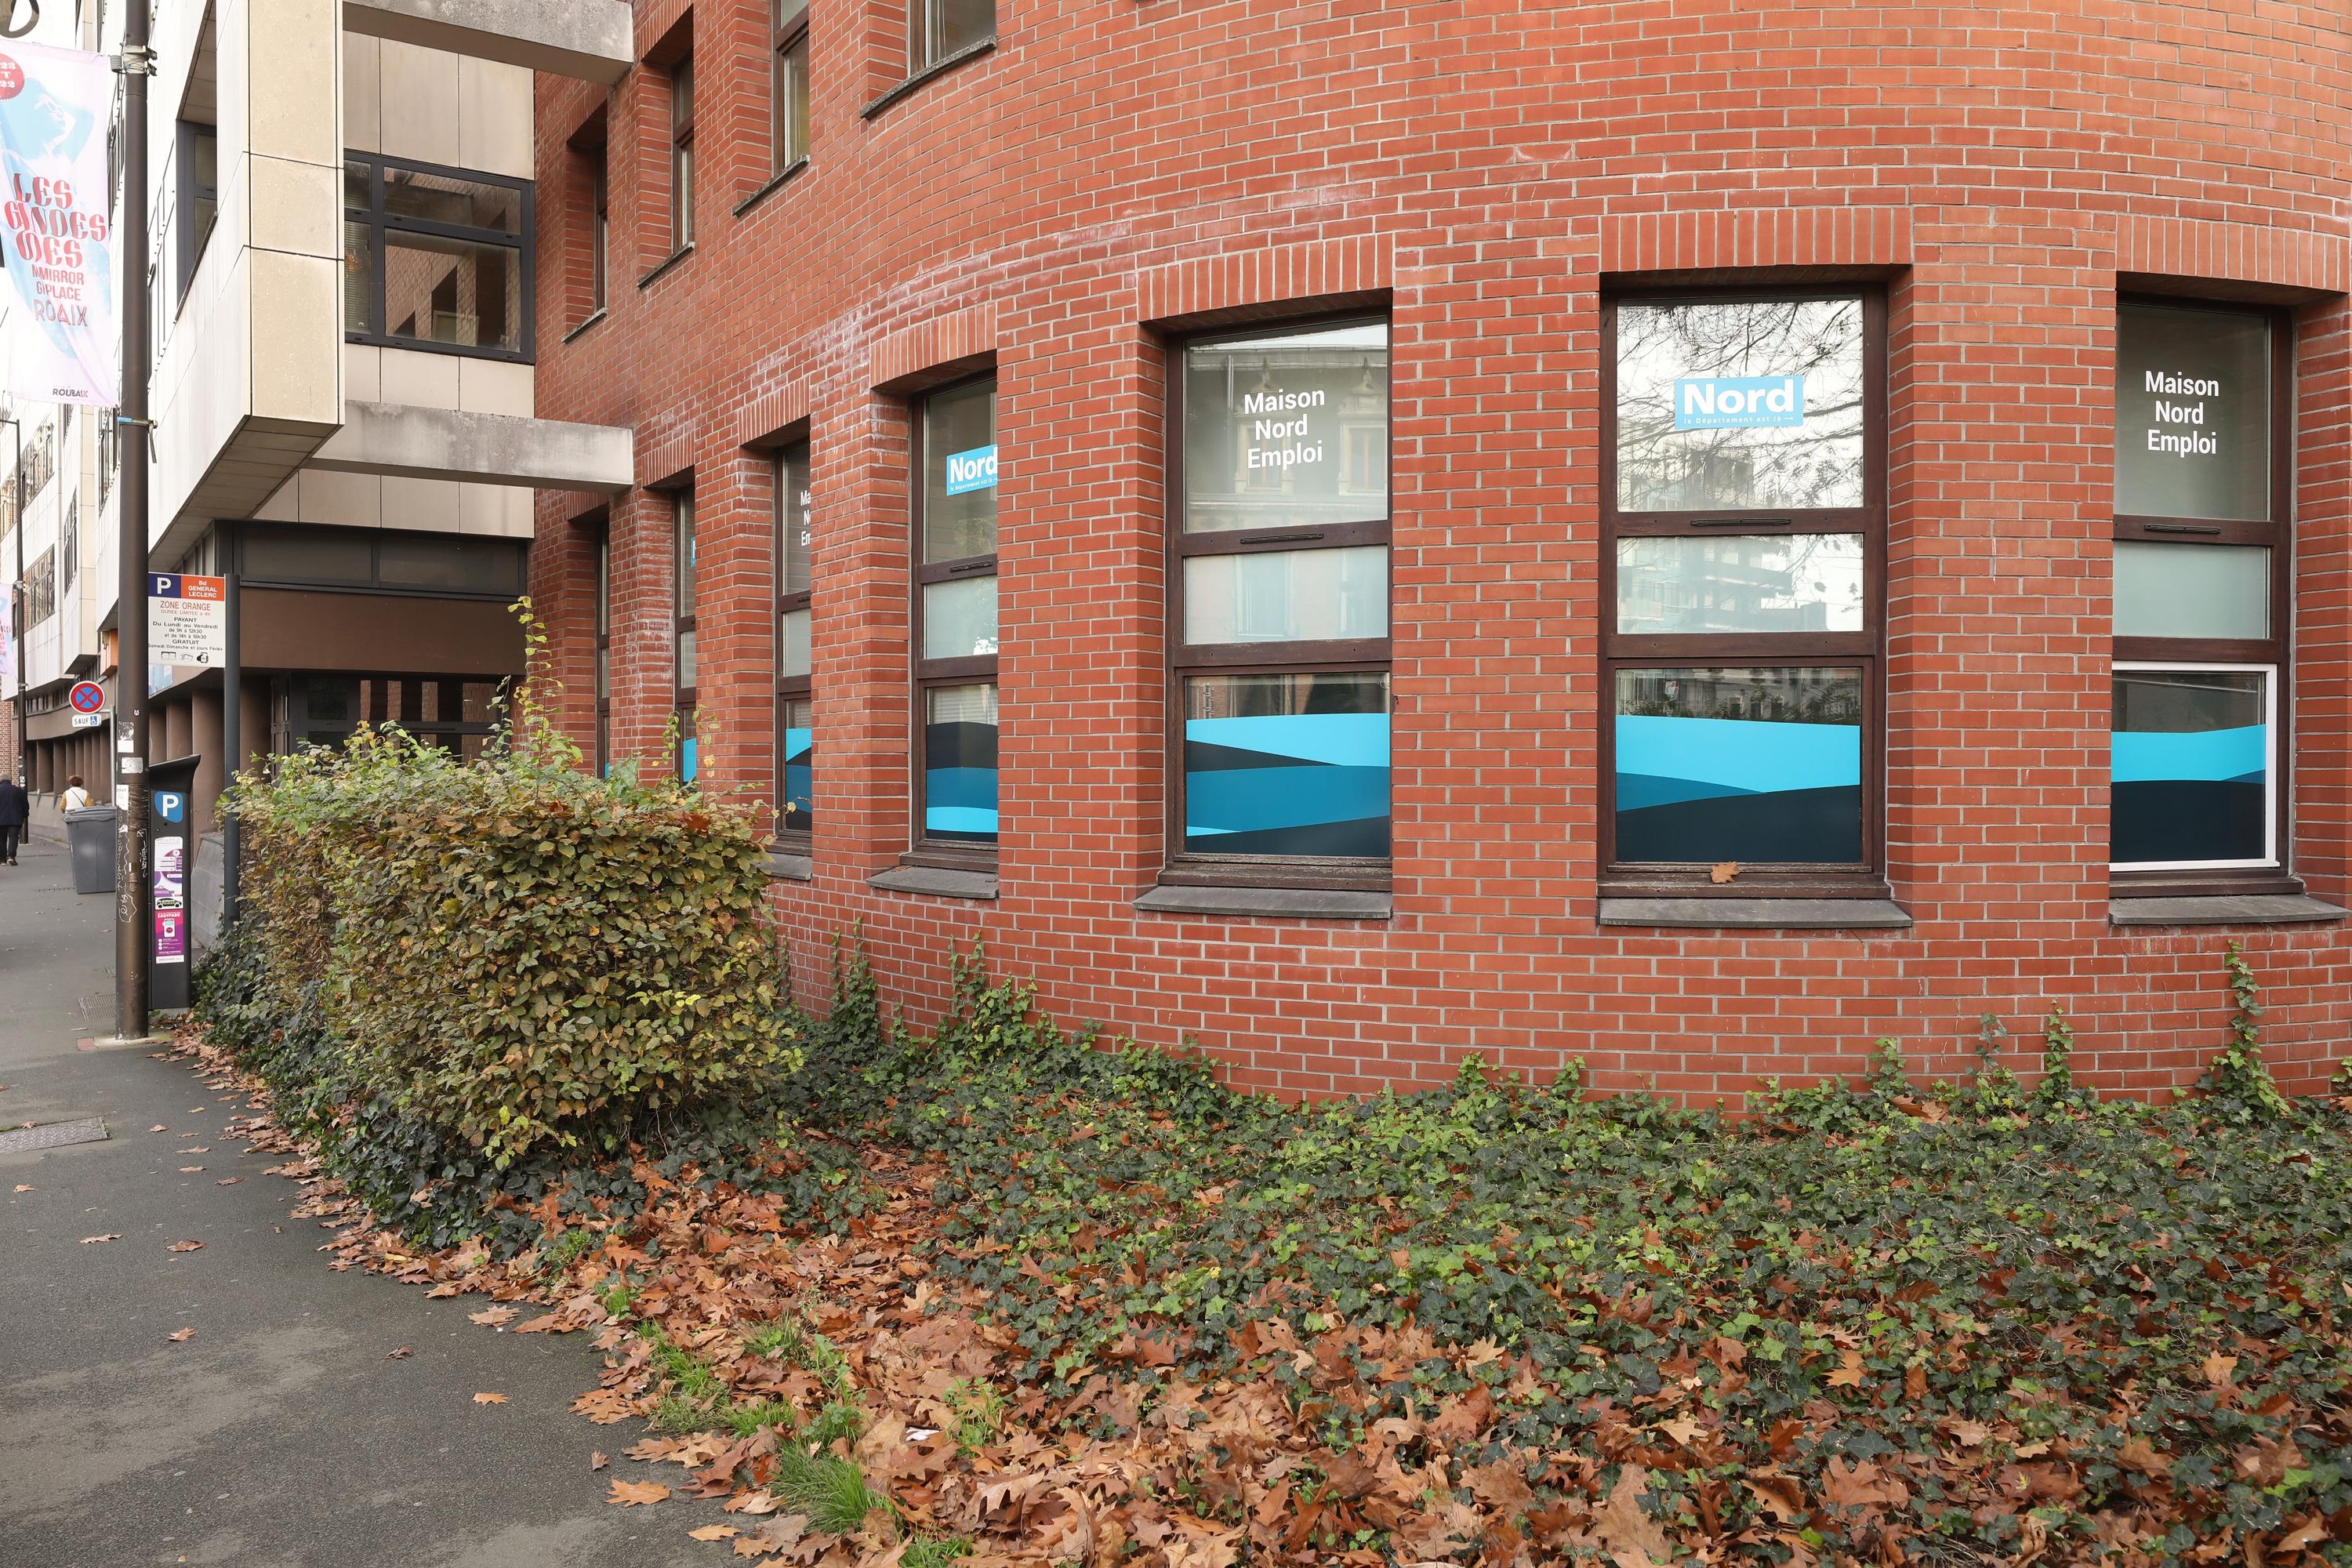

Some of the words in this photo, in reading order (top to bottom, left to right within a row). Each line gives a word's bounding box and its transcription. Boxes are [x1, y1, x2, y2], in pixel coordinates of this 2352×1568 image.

[13, 173, 73, 209] LES
[53, 388, 88, 397] ROUBAIX
[2145, 370, 2220, 397] Maison
[1244, 389, 1325, 414] Maison
[1684, 379, 1794, 415] Nord
[2155, 401, 2204, 424] Nord
[1255, 414, 1308, 440] Nord
[1247, 440, 1323, 470] Emploi
[2147, 429, 2216, 458] Emploi
[950, 446, 998, 484] Nord
[157, 577, 171, 594] P
[160, 601, 180, 609] ZONE
[182, 602, 211, 611] ORANGE
[163, 795, 179, 817] P
